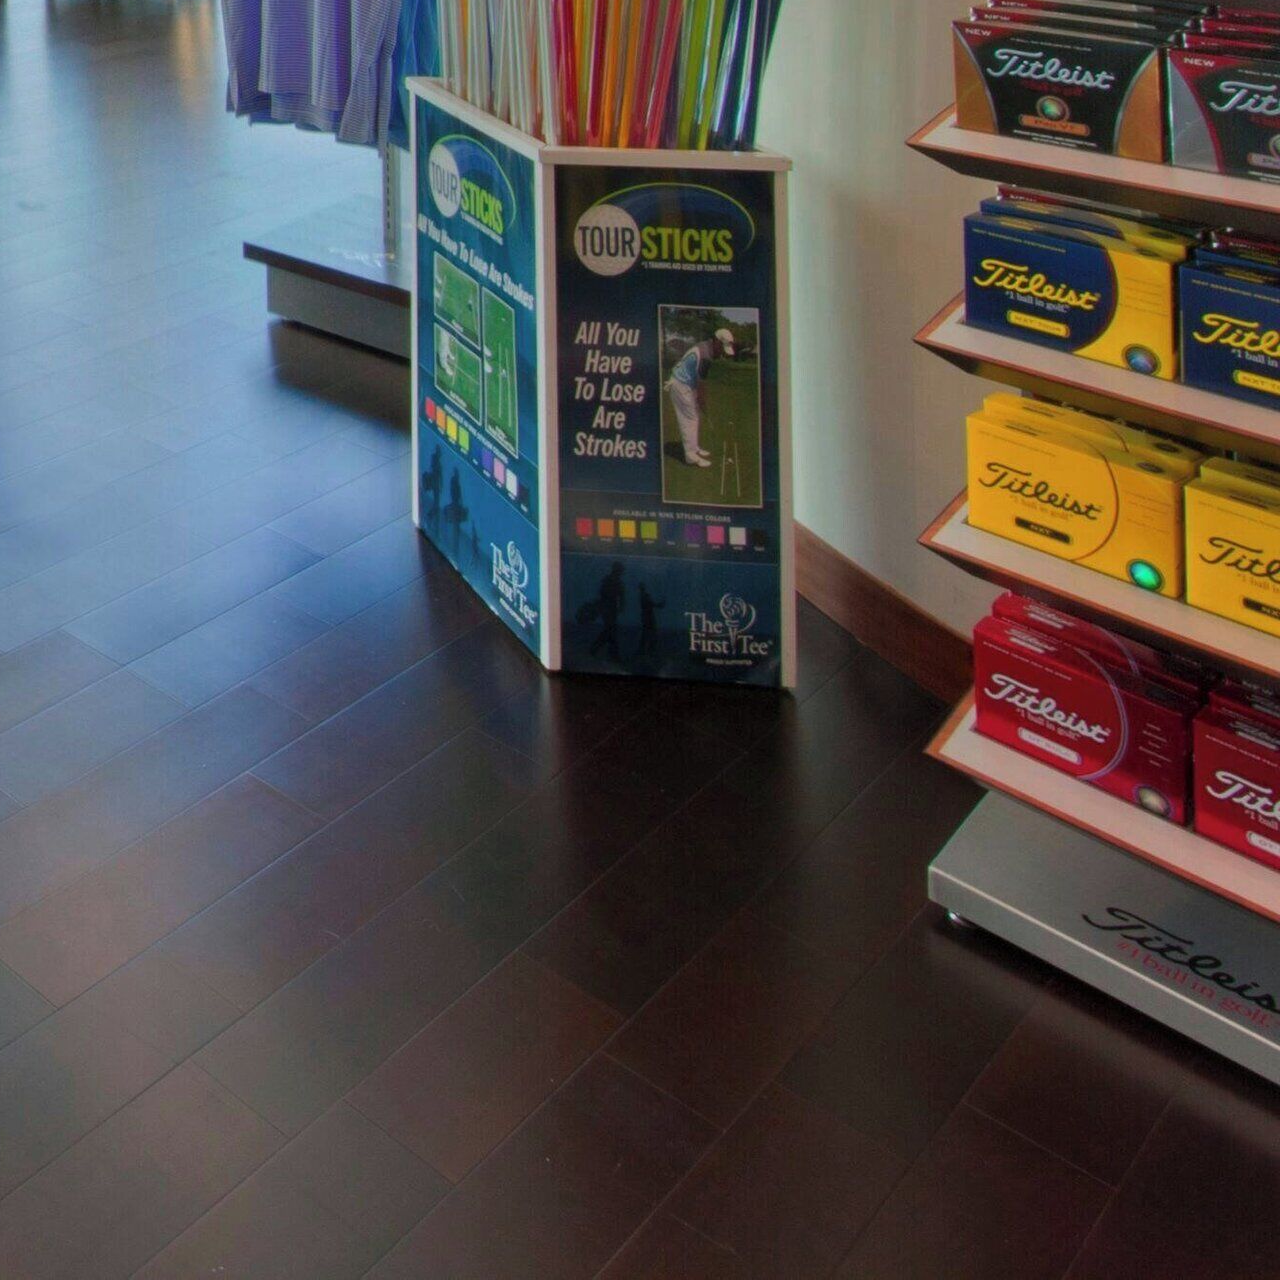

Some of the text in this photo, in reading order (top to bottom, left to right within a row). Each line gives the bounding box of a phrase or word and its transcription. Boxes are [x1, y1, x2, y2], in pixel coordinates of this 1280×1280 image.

[965, 28, 991, 36] NEW
[986, 48, 1115, 89] Titleist
[1184, 57, 1215, 67] NEW
[432, 162, 458, 202] TOUR
[461, 178, 504, 234] STICKS
[460, 241, 469, 263] To
[469, 248, 489, 277] Lose
[578, 225, 733, 263] TOUR STICKS
[973, 259, 1101, 310] Titleist
[574, 321, 640, 347] All You
[1192, 313, 1280, 357] Titl
[584, 349, 632, 374] Have
[574, 377, 645, 403] To Lose
[592, 405, 626, 430] Are
[574, 432, 647, 459] Strokes
[978, 462, 1103, 520] Titleist
[685, 611, 723, 634] The
[690, 633, 768, 655] First Tee
[983, 673, 1111, 743] Titleist
[1140, 952, 1190, 986] ball
[1190, 978, 1217, 1000] in
